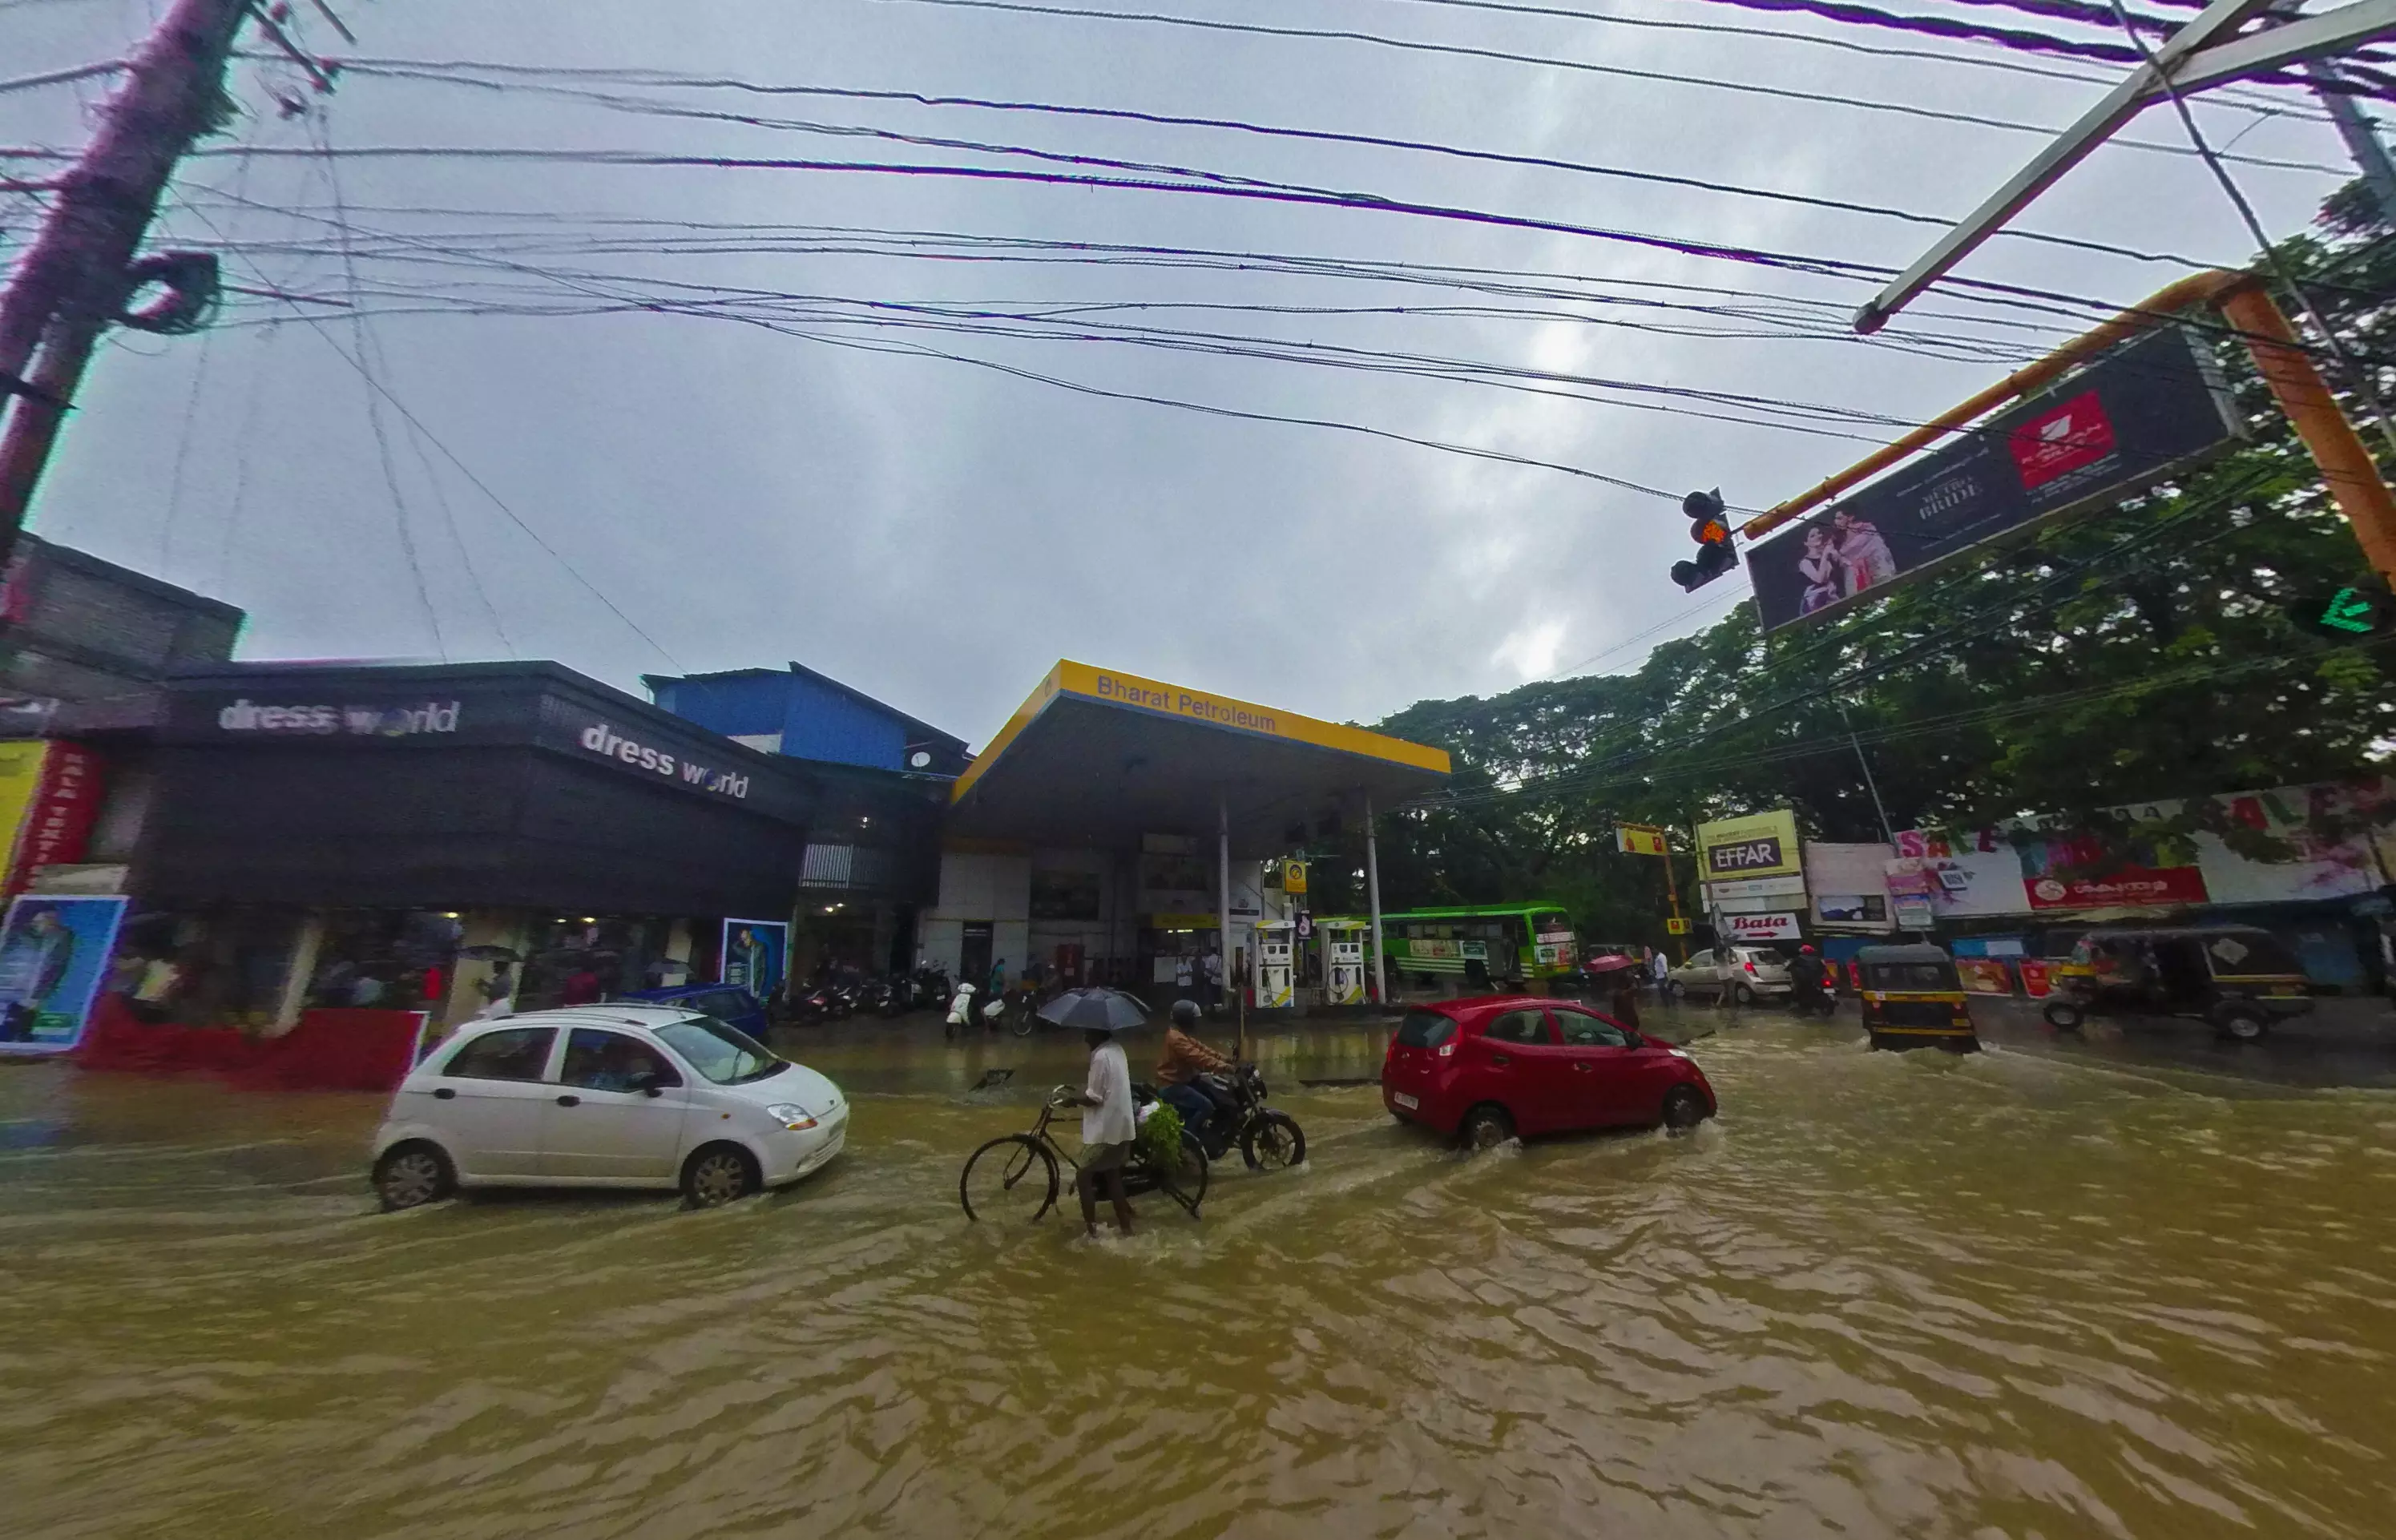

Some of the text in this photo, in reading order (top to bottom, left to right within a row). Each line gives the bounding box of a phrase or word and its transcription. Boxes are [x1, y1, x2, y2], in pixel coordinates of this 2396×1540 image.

[218, 699, 340, 736] dress
[1097, 675, 1276, 732] Bharat Petroleum
[580, 724, 675, 776] dress
[1716, 843, 1775, 869] EFFAR
[1732, 915, 1789, 930] Bata
